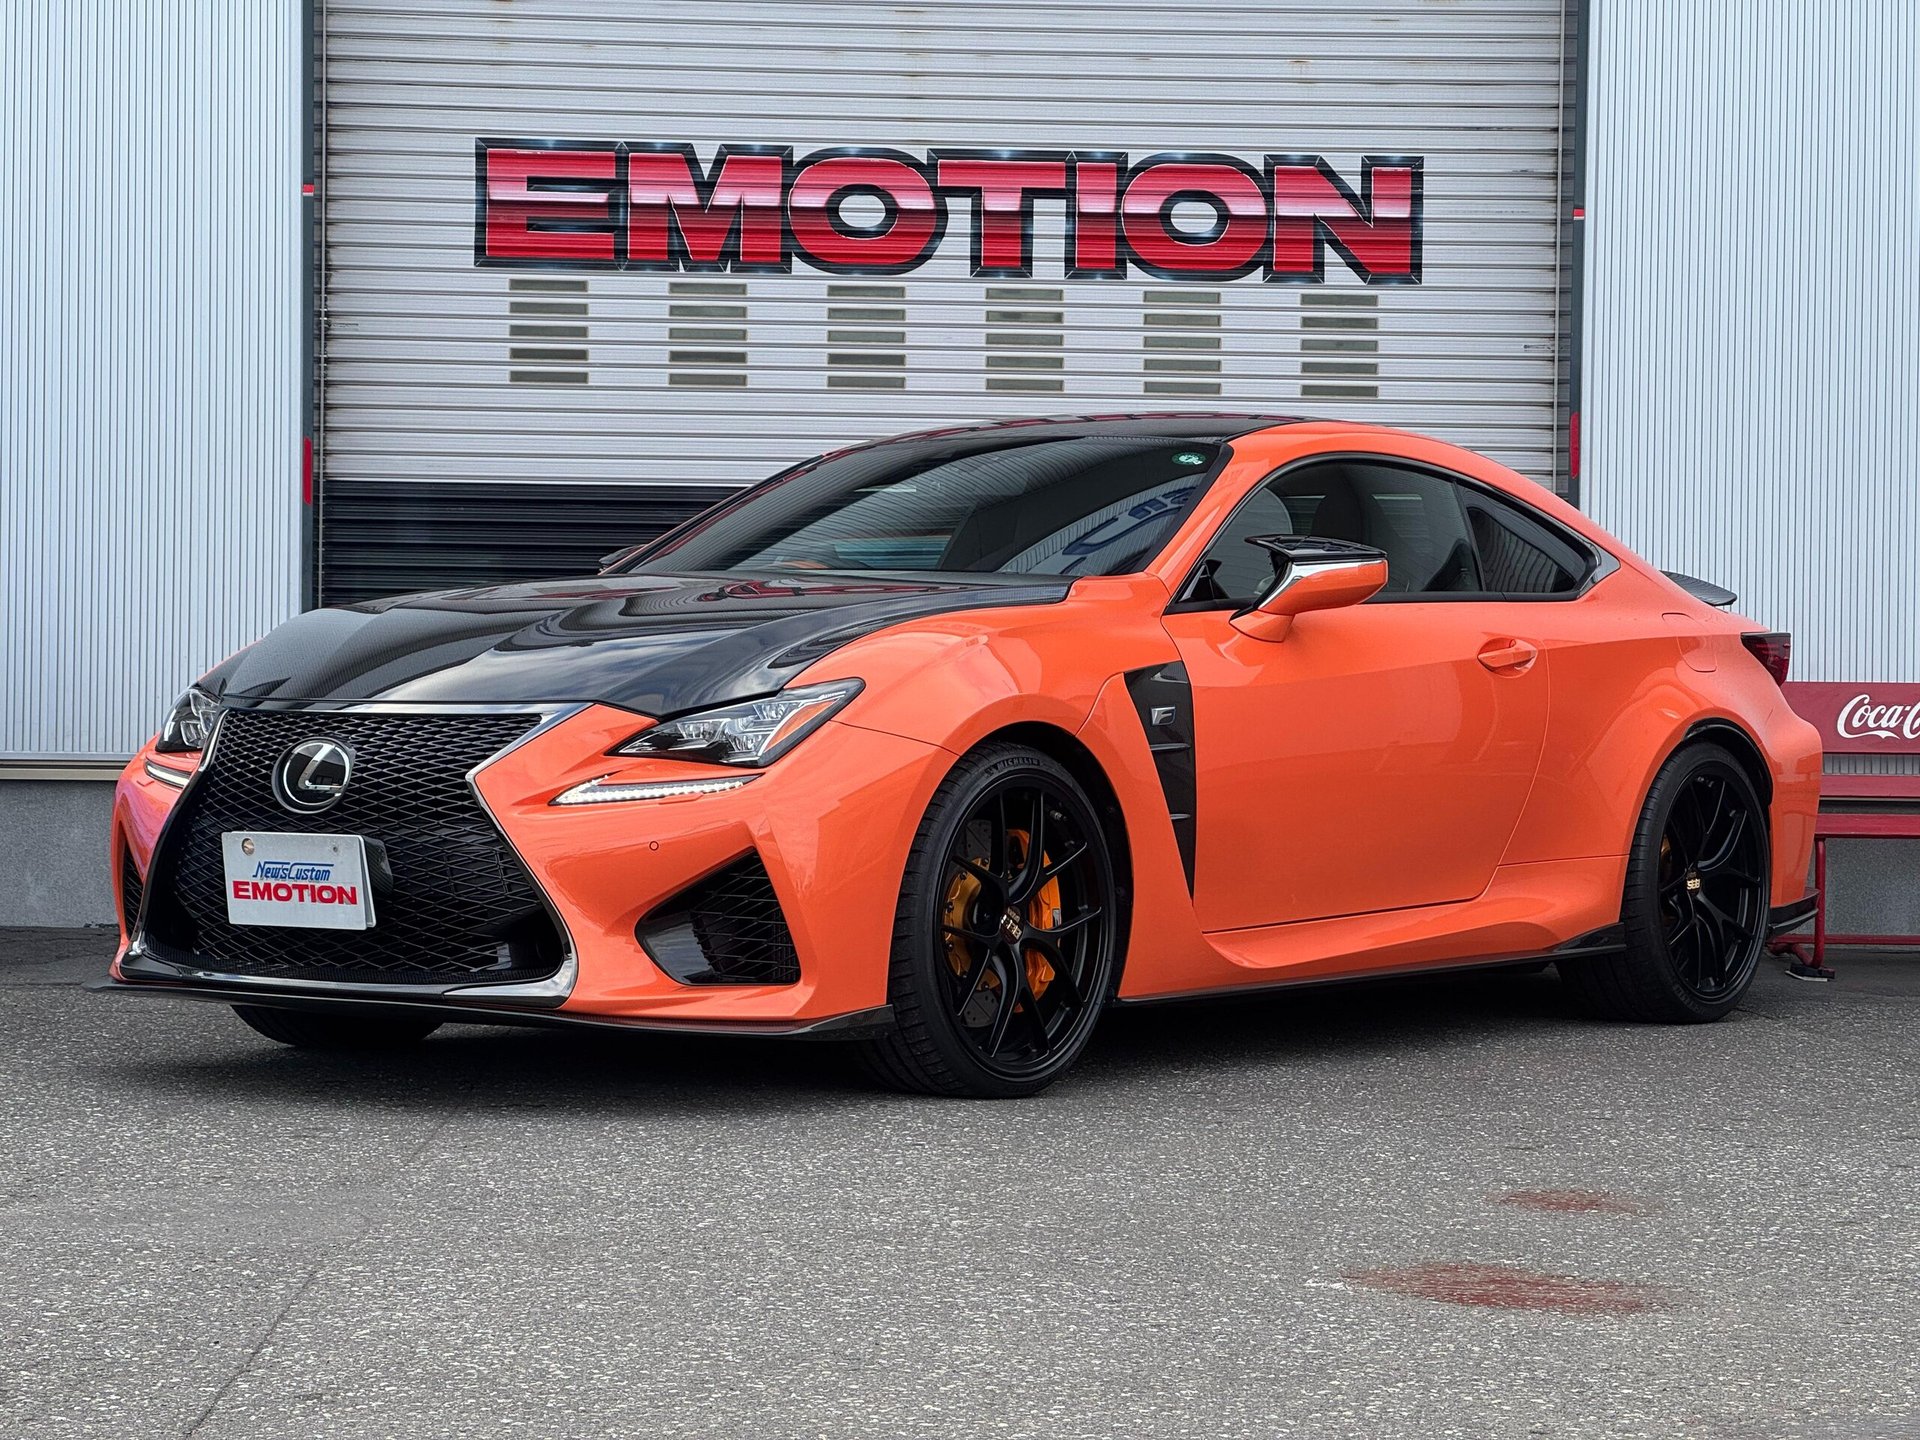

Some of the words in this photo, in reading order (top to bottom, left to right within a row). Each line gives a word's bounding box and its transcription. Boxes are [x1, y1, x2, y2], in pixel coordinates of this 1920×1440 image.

[475, 137, 1423, 284] EMOTION
[997, 756, 1041, 770] MICHELIN
[232, 881, 357, 905] EMOTION
